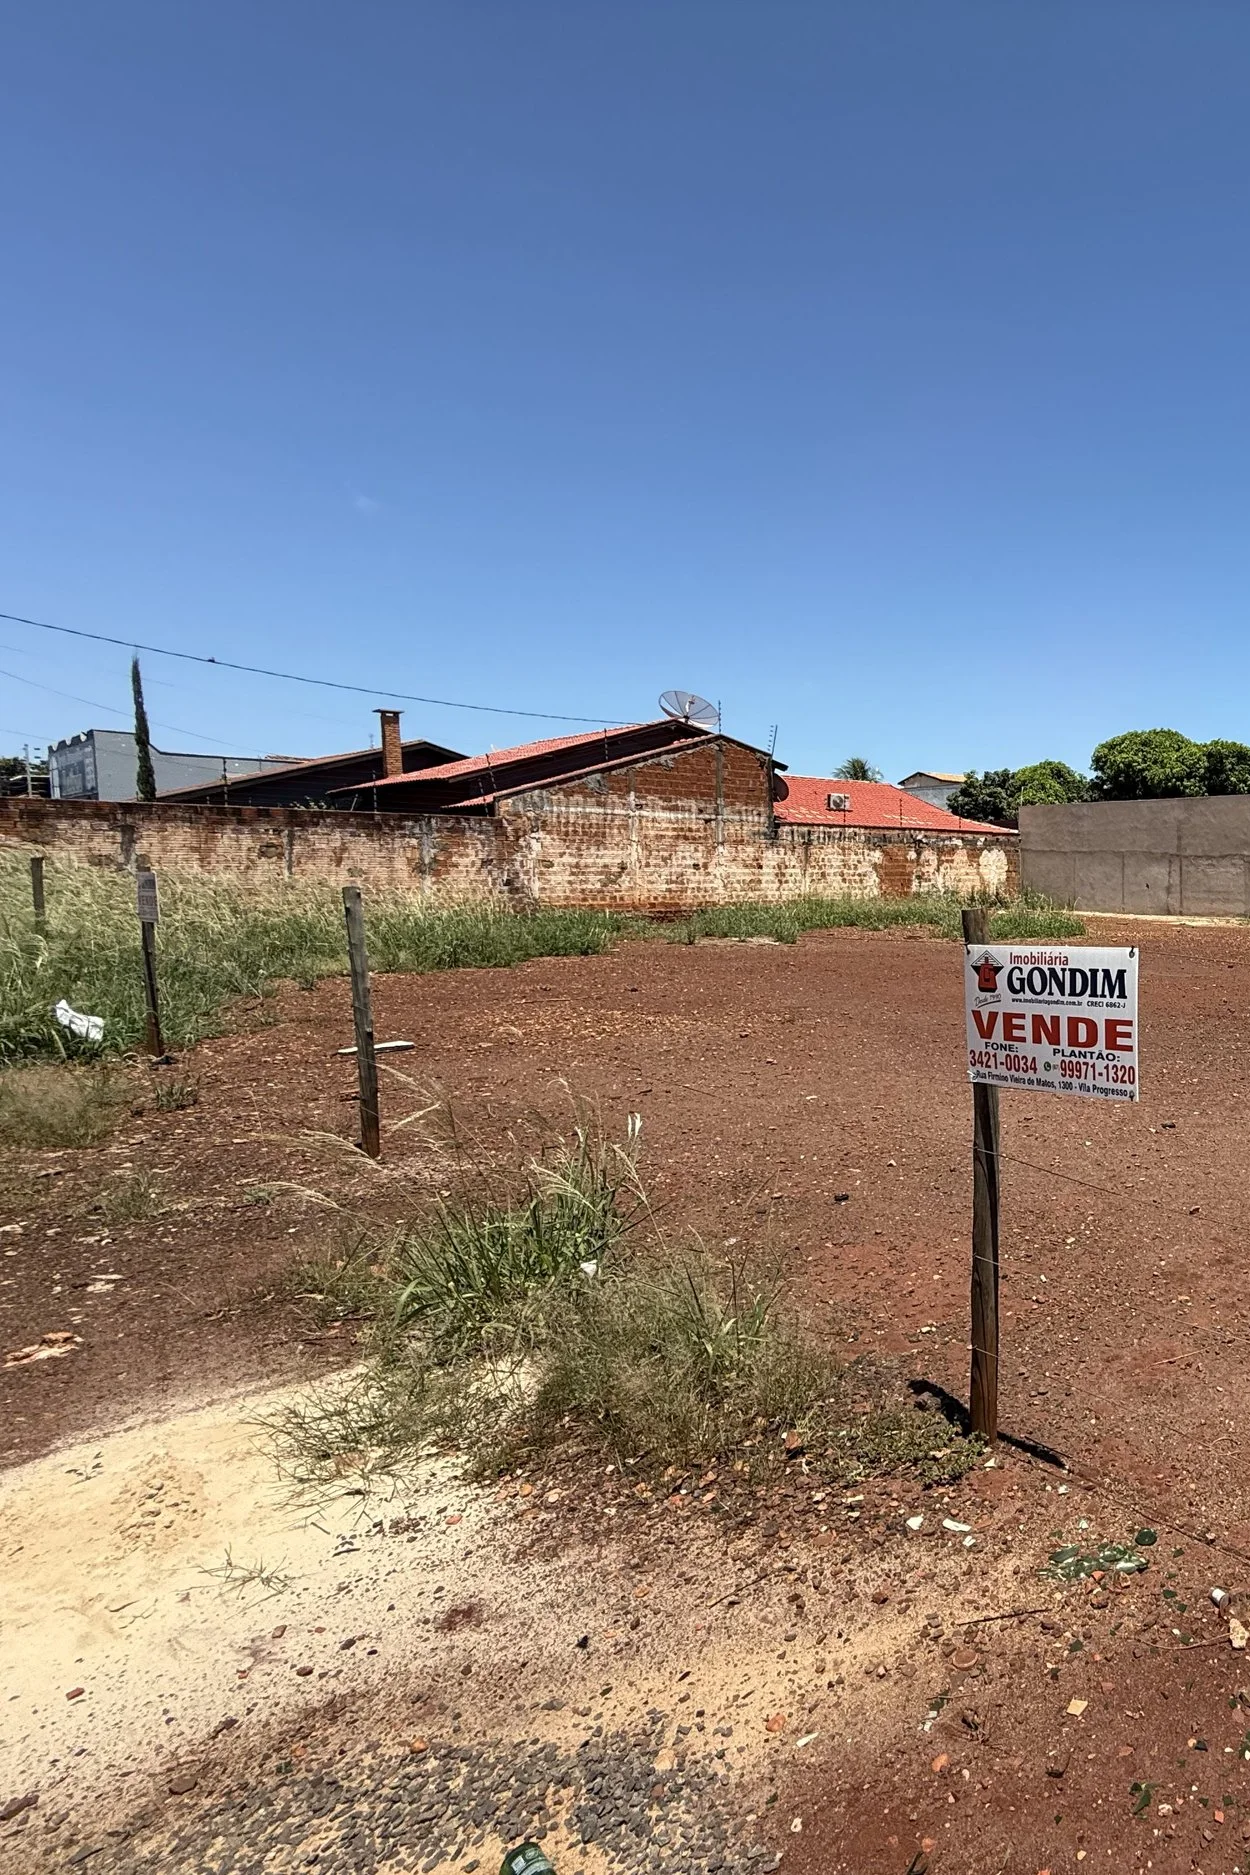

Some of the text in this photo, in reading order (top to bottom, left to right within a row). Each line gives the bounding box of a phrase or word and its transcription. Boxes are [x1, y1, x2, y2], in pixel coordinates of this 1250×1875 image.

[1009, 952, 1069, 966] Imobiliária
[1007, 966, 1127, 999] GONDIM
[1086, 1000, 1104, 1008] CRECI
[1105, 1001, 1126, 1009] 6862-J
[971, 1010, 1133, 1052] VENDE
[984, 1041, 1019, 1053] FONE:
[1052, 1048, 1120, 1062] PLANTÃO:
[969, 1049, 1038, 1075] 3421-0034
[1060, 1059, 1136, 1085] 99971-1320
[987, 1071, 1009, 1083] Firmino
[1009, 1074, 1026, 1085] Vieira
[1026, 1076, 1036, 1086] de
[1058, 1081, 1074, 1091] 1300
[1078, 1082, 1091, 1093] Vila
[1092, 1084, 1129, 1097] Progresso
